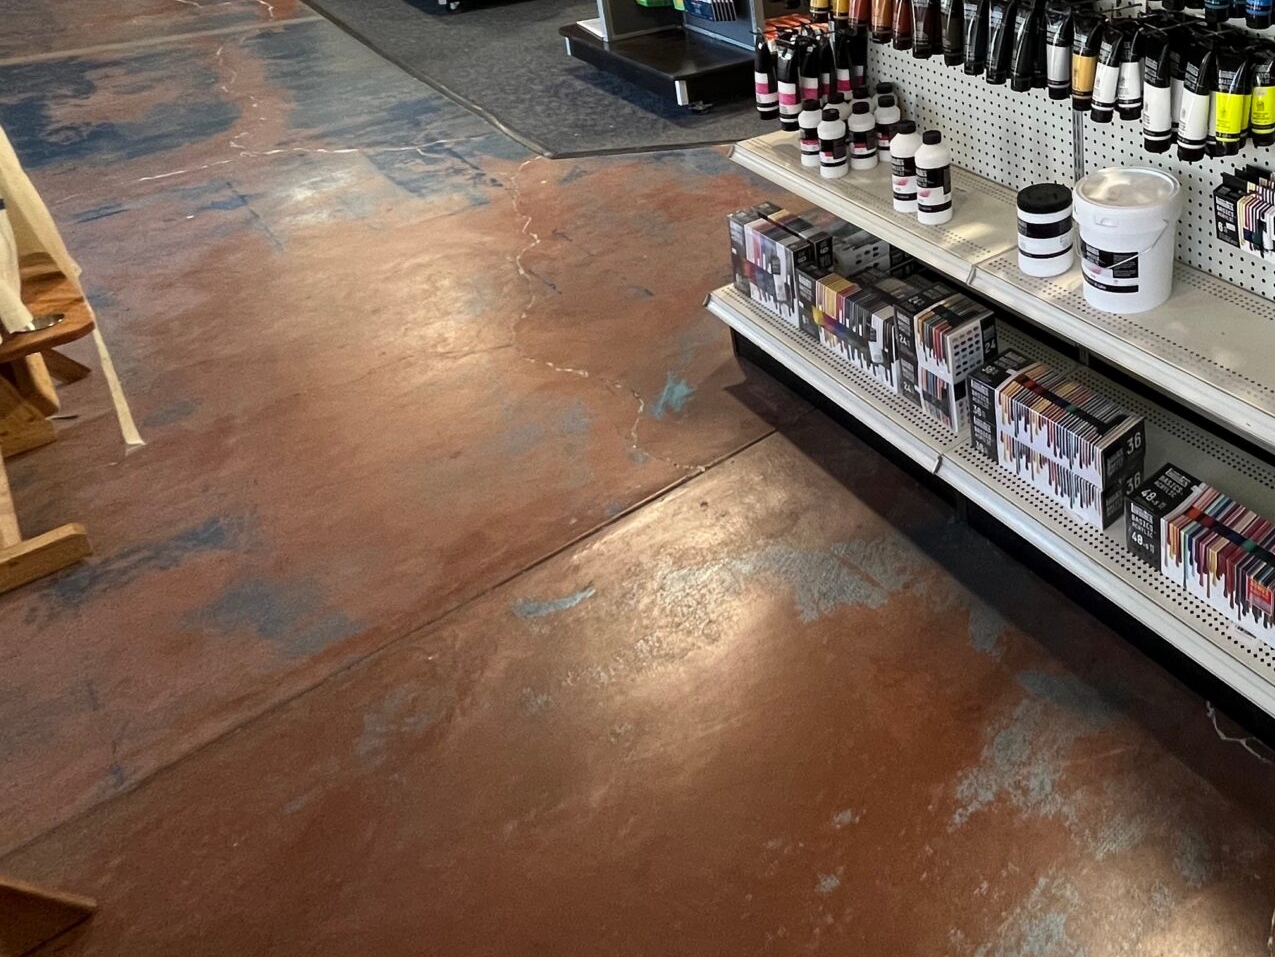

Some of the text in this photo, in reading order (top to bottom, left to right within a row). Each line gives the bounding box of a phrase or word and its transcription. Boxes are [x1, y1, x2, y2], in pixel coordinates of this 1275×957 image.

[1217, 222, 1224, 233] 6
[984, 339, 997, 354] 24
[1126, 431, 1142, 455] 36
[1126, 472, 1141, 494] 36
[1141, 489, 1155, 502] 48
[1131, 531, 1144, 546] 48
